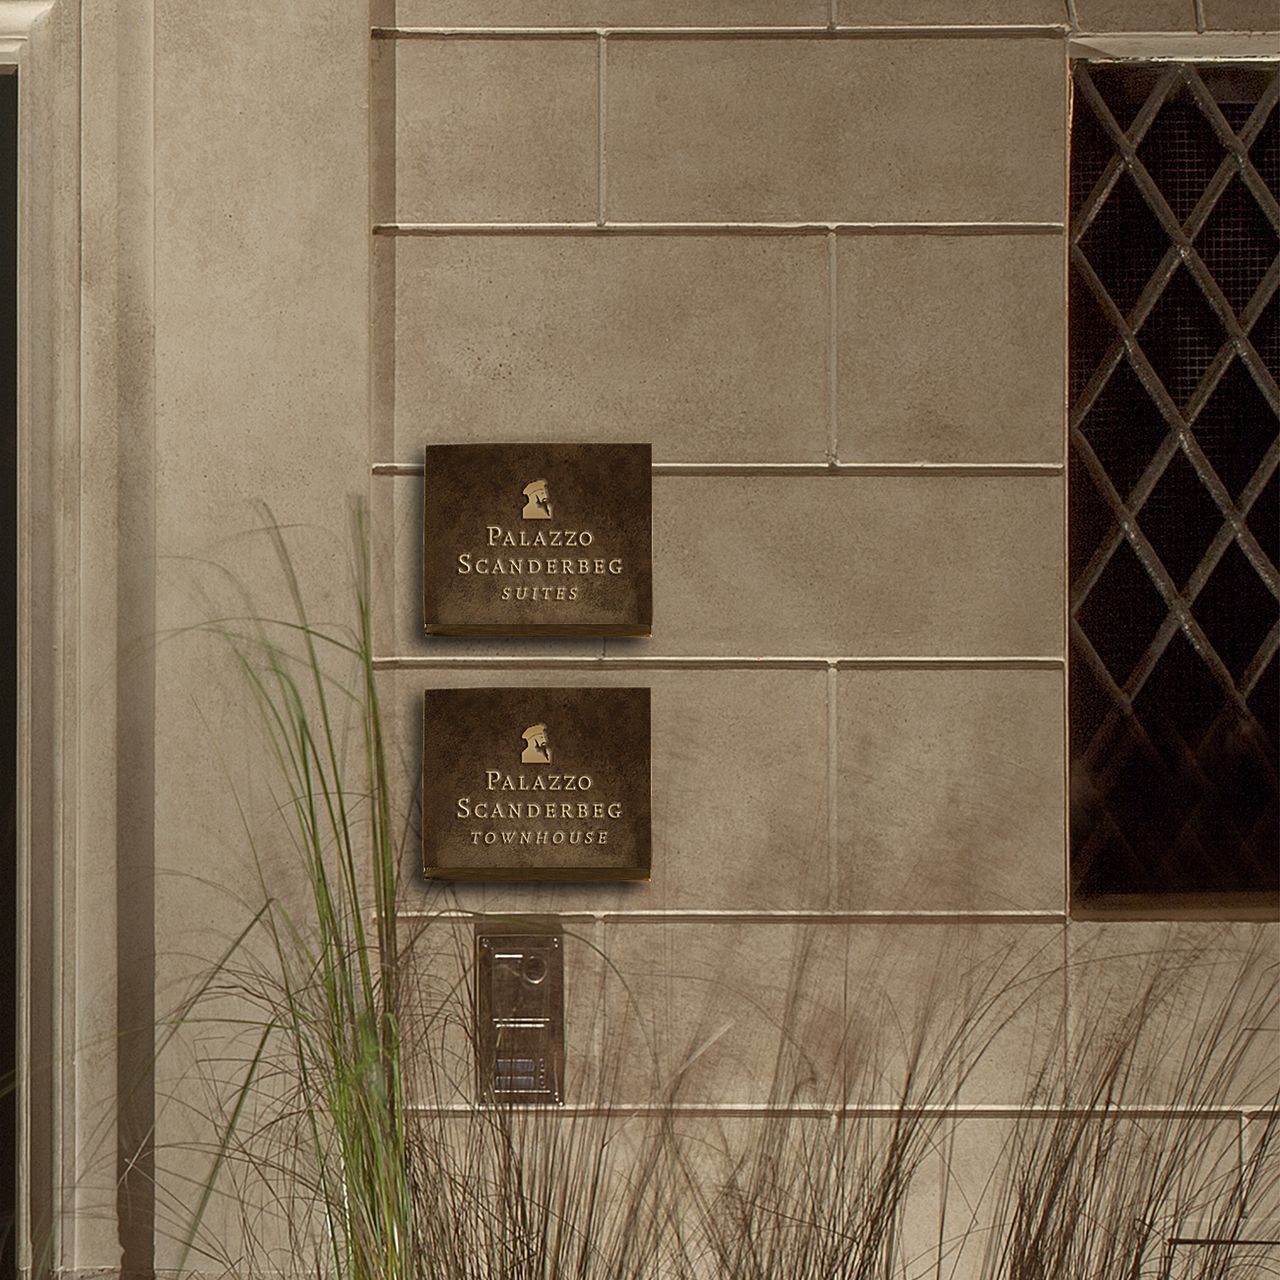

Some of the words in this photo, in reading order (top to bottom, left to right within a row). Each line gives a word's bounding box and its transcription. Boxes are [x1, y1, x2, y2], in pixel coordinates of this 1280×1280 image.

[487, 526, 593, 546] PALAZZO
[458, 554, 623, 575] SCANDERBEG
[501, 587, 578, 600] SUITES
[486, 770, 592, 791] PALAZZO
[457, 798, 623, 819] SCANDERBEG
[470, 831, 609, 844] TOWNHOUSE
